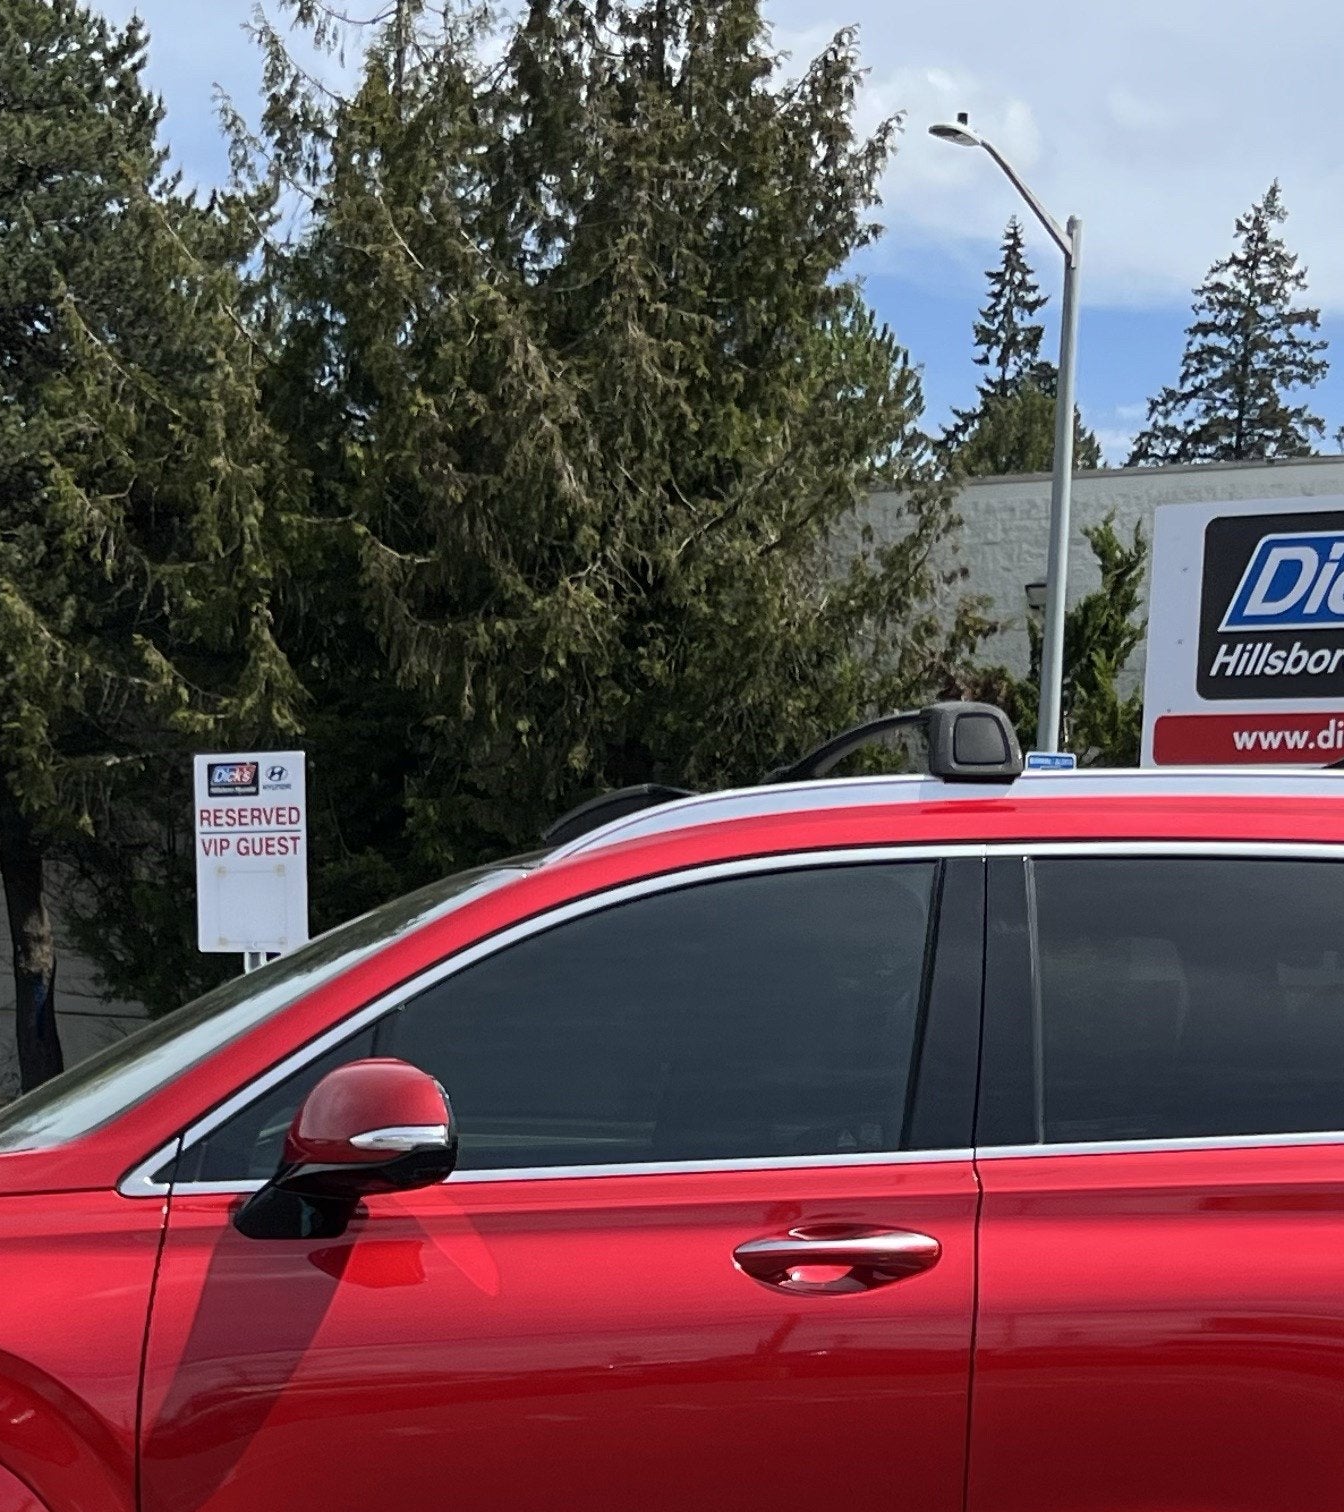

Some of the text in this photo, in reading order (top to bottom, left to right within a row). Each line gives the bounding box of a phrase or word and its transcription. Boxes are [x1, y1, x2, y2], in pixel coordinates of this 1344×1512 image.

[199, 806, 301, 828] RESERVED
[201, 836, 301, 856] VIP GUEST
